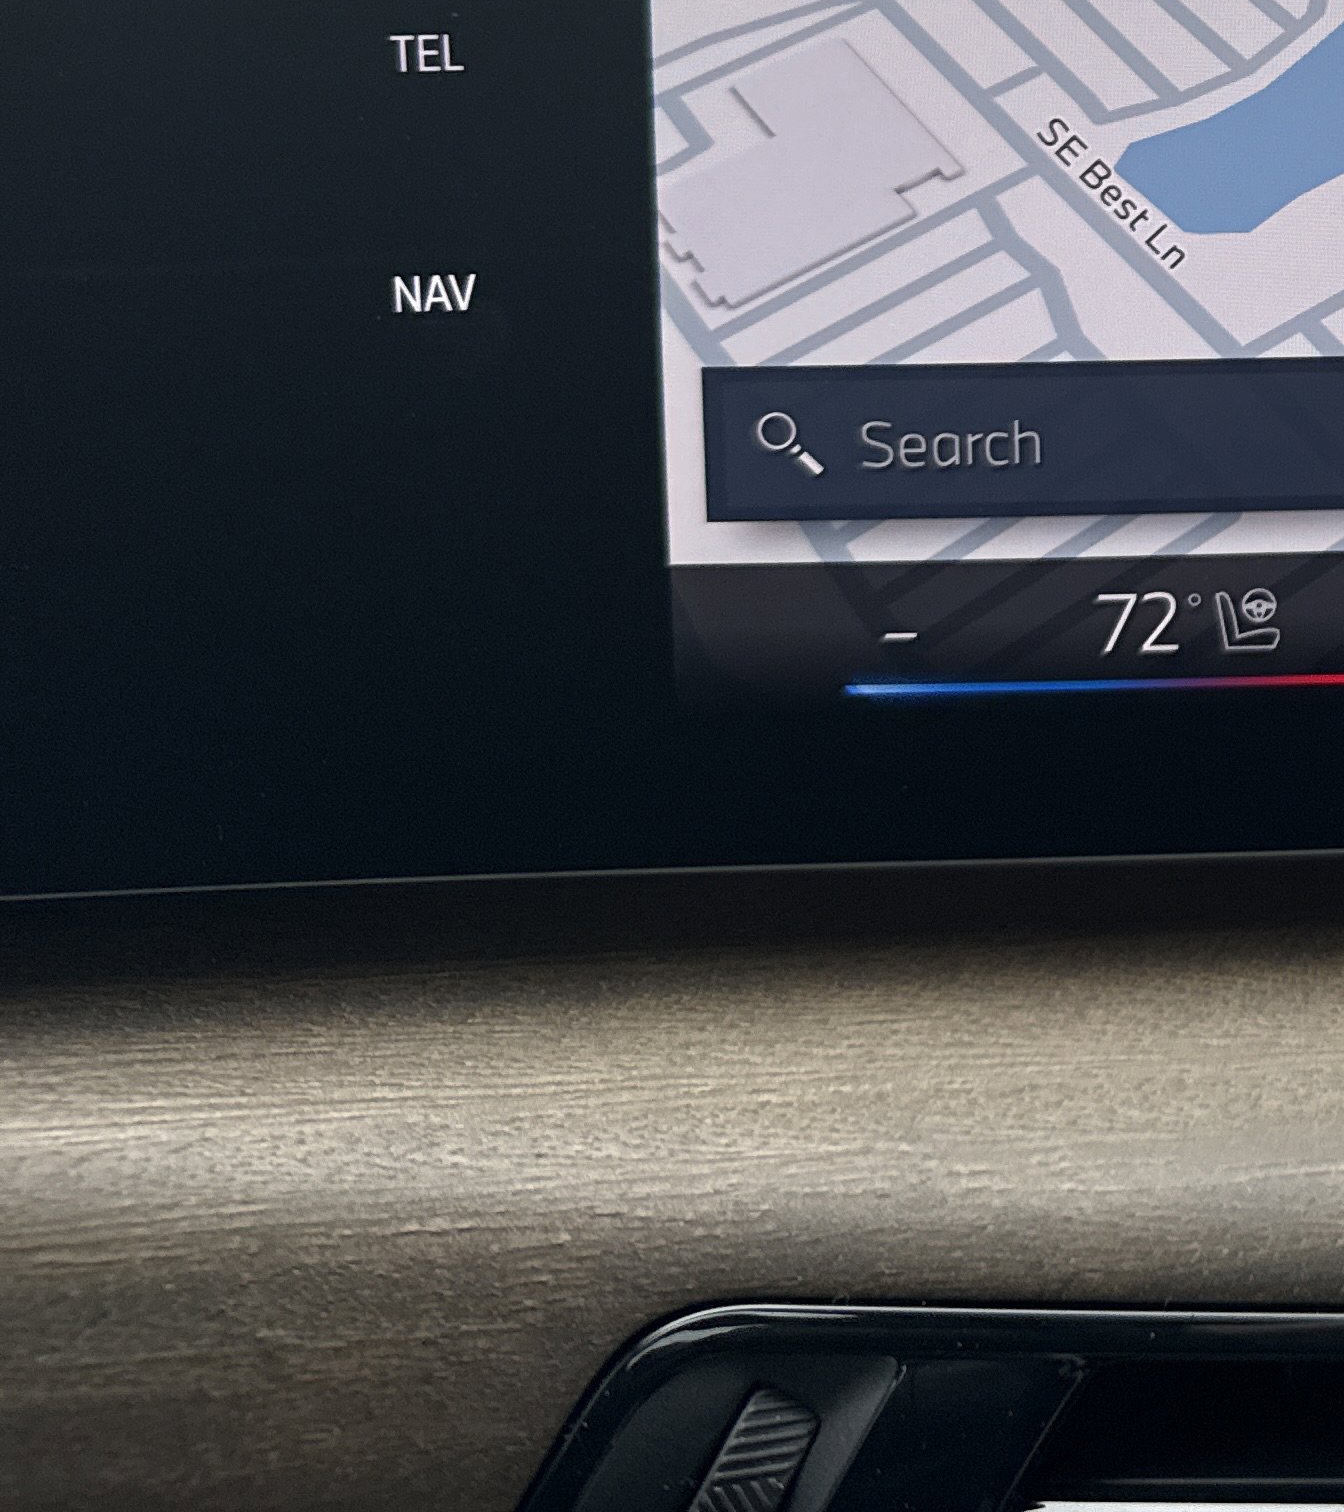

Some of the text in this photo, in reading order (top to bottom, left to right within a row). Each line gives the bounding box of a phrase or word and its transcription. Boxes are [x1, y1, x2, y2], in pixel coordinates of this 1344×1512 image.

[389, 33, 465, 73] TEL
[1036, 117, 1187, 270] SE Best Ln
[391, 273, 477, 314] NAV
[860, 419, 1043, 469] Search
